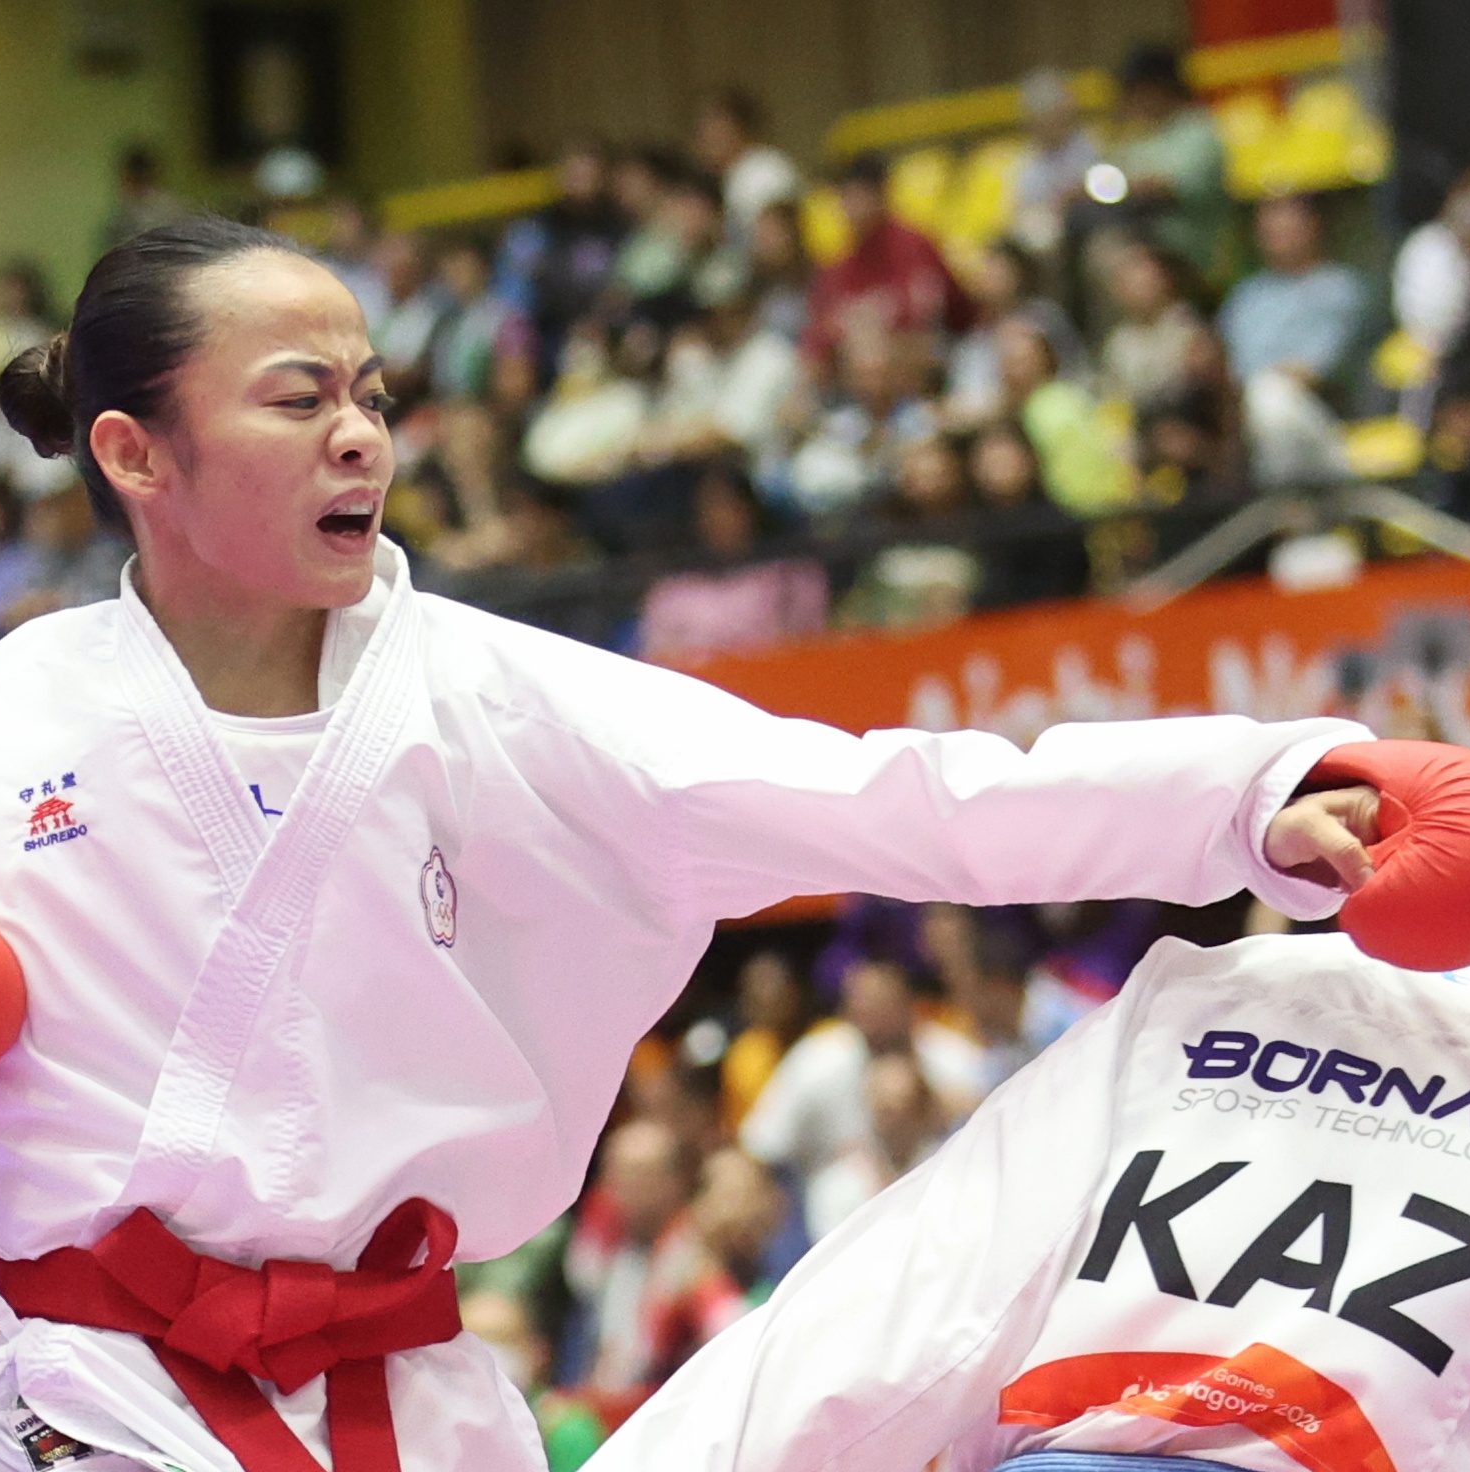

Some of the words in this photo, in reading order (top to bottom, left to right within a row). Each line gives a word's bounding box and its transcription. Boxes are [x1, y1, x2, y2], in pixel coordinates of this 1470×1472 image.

[24, 824, 88, 851] SHUREIDO
[1172, 1088, 1301, 1121] SPORTS
[1213, 1368, 1276, 1400] Games
[1272, 1402, 1323, 1434] 2026
